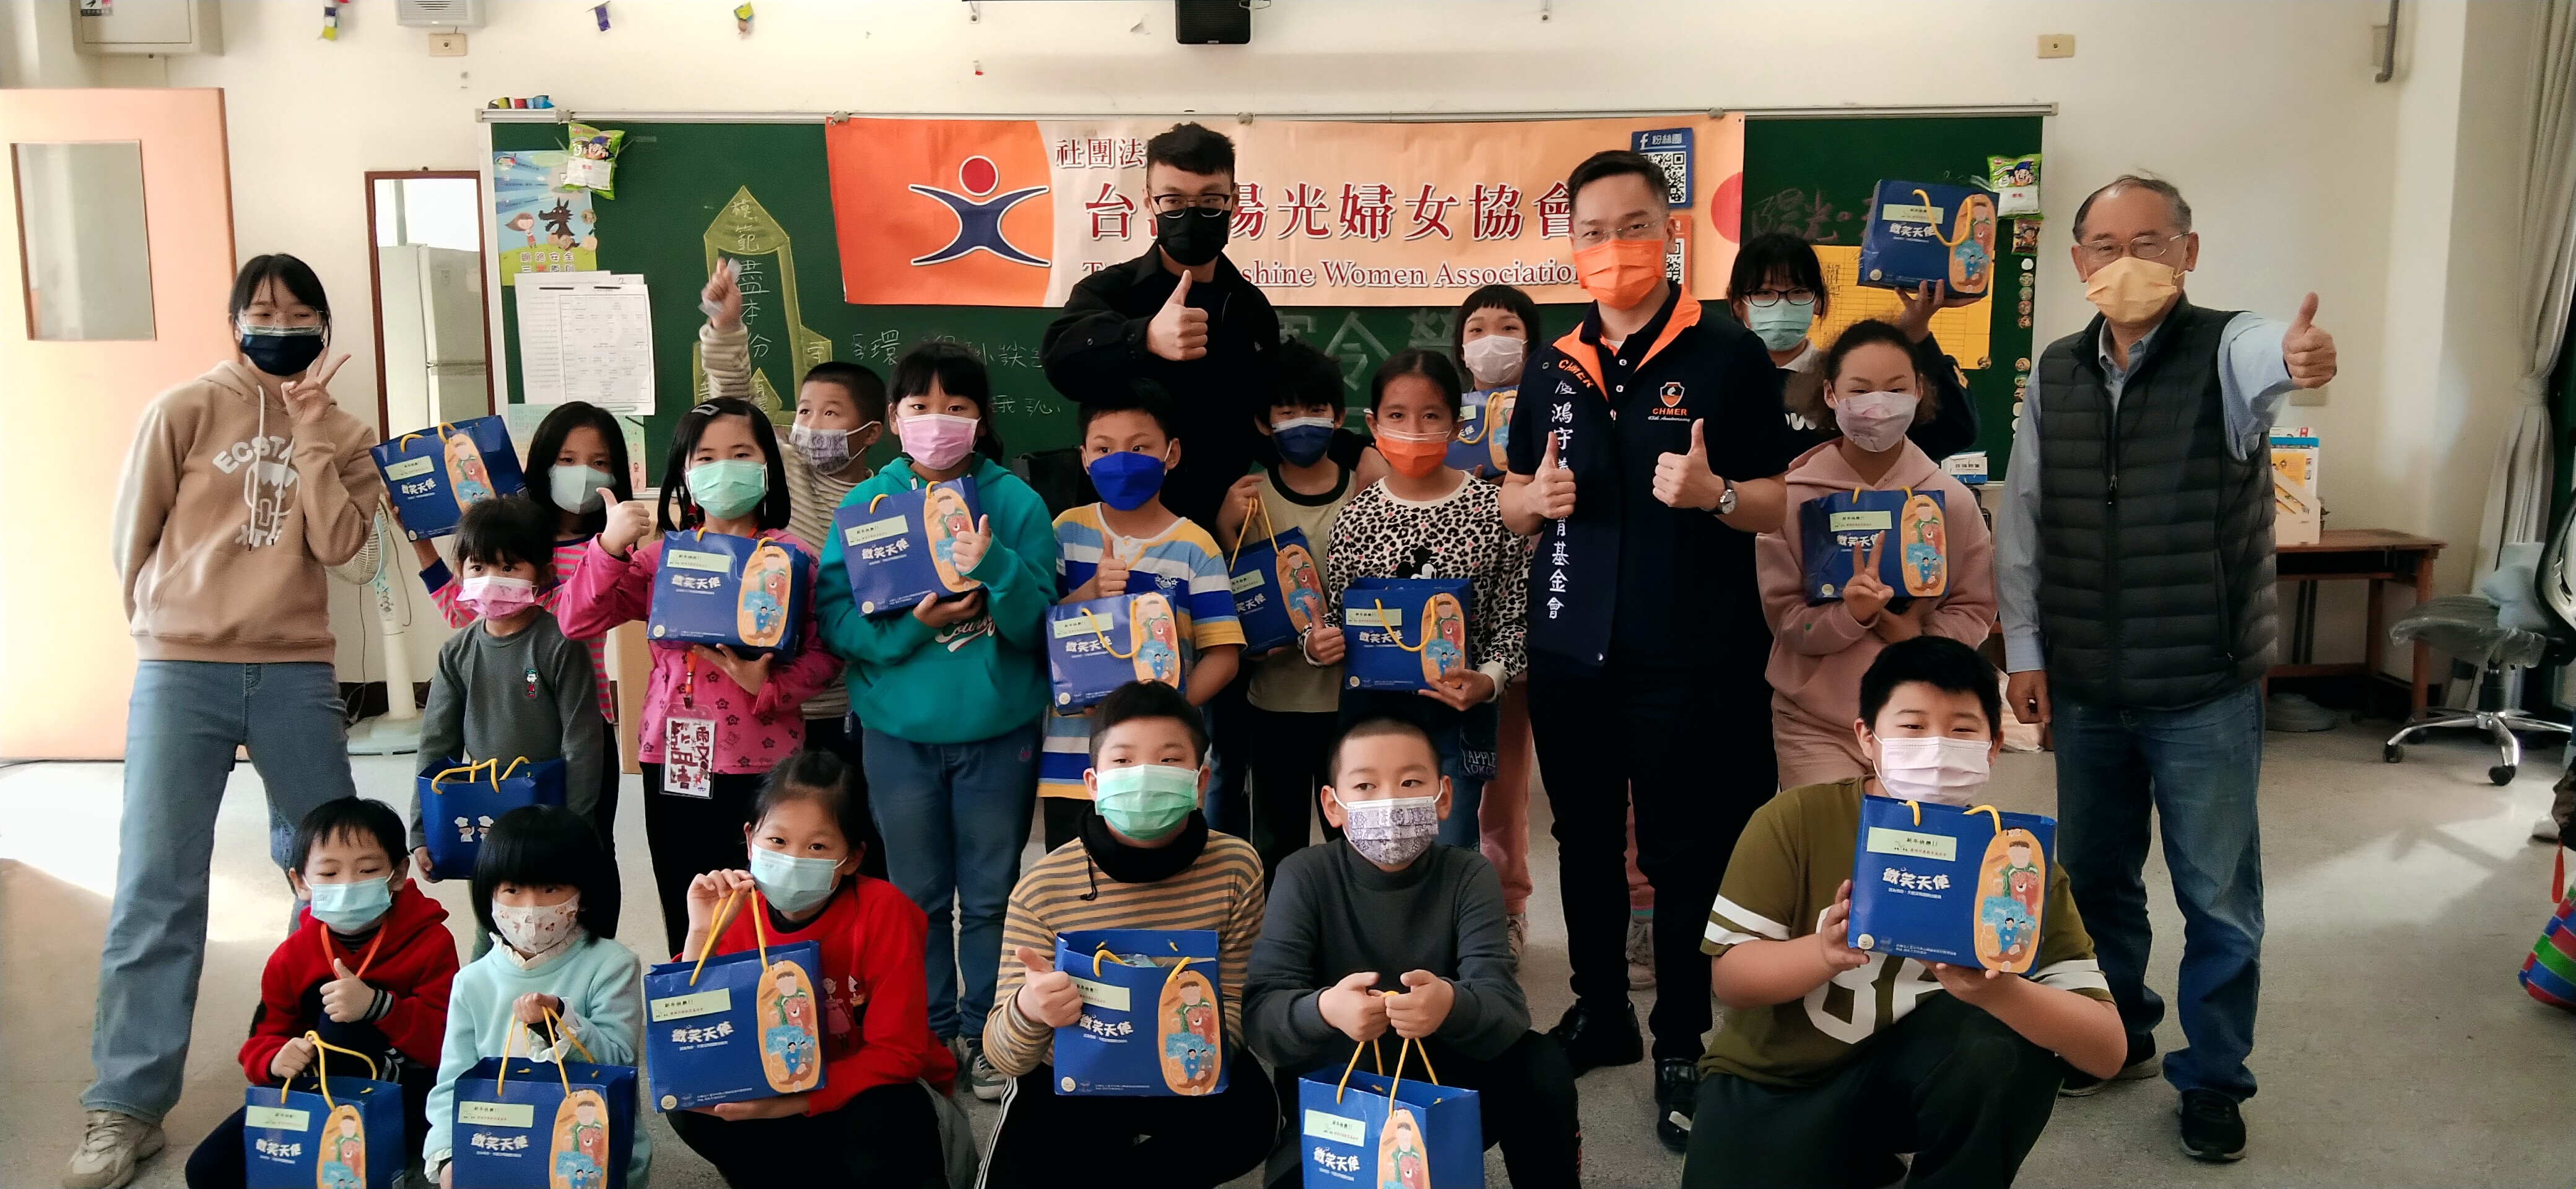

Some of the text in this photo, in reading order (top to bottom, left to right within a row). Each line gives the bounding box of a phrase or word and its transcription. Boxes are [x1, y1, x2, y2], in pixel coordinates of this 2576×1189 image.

[1652, 133, 1682, 145] 粉絲團
[1085, 181, 1573, 241] 台陽光婦女協會
[1321, 260, 1426, 287] Women
[1557, 359, 1595, 388] CHMER
[1652, 407, 1687, 416] CHMER
[861, 538, 910, 560] 微笑天使
[1468, 750, 1497, 767] APPLE
[1882, 867, 1951, 891] 微笑天使
[672, 1021, 734, 1043] 微笑天使
[1079, 1014, 1134, 1037] 微笑天使
[471, 1133, 529, 1151] 微笑天使
[1313, 1146, 1360, 1172] 微笑天使
